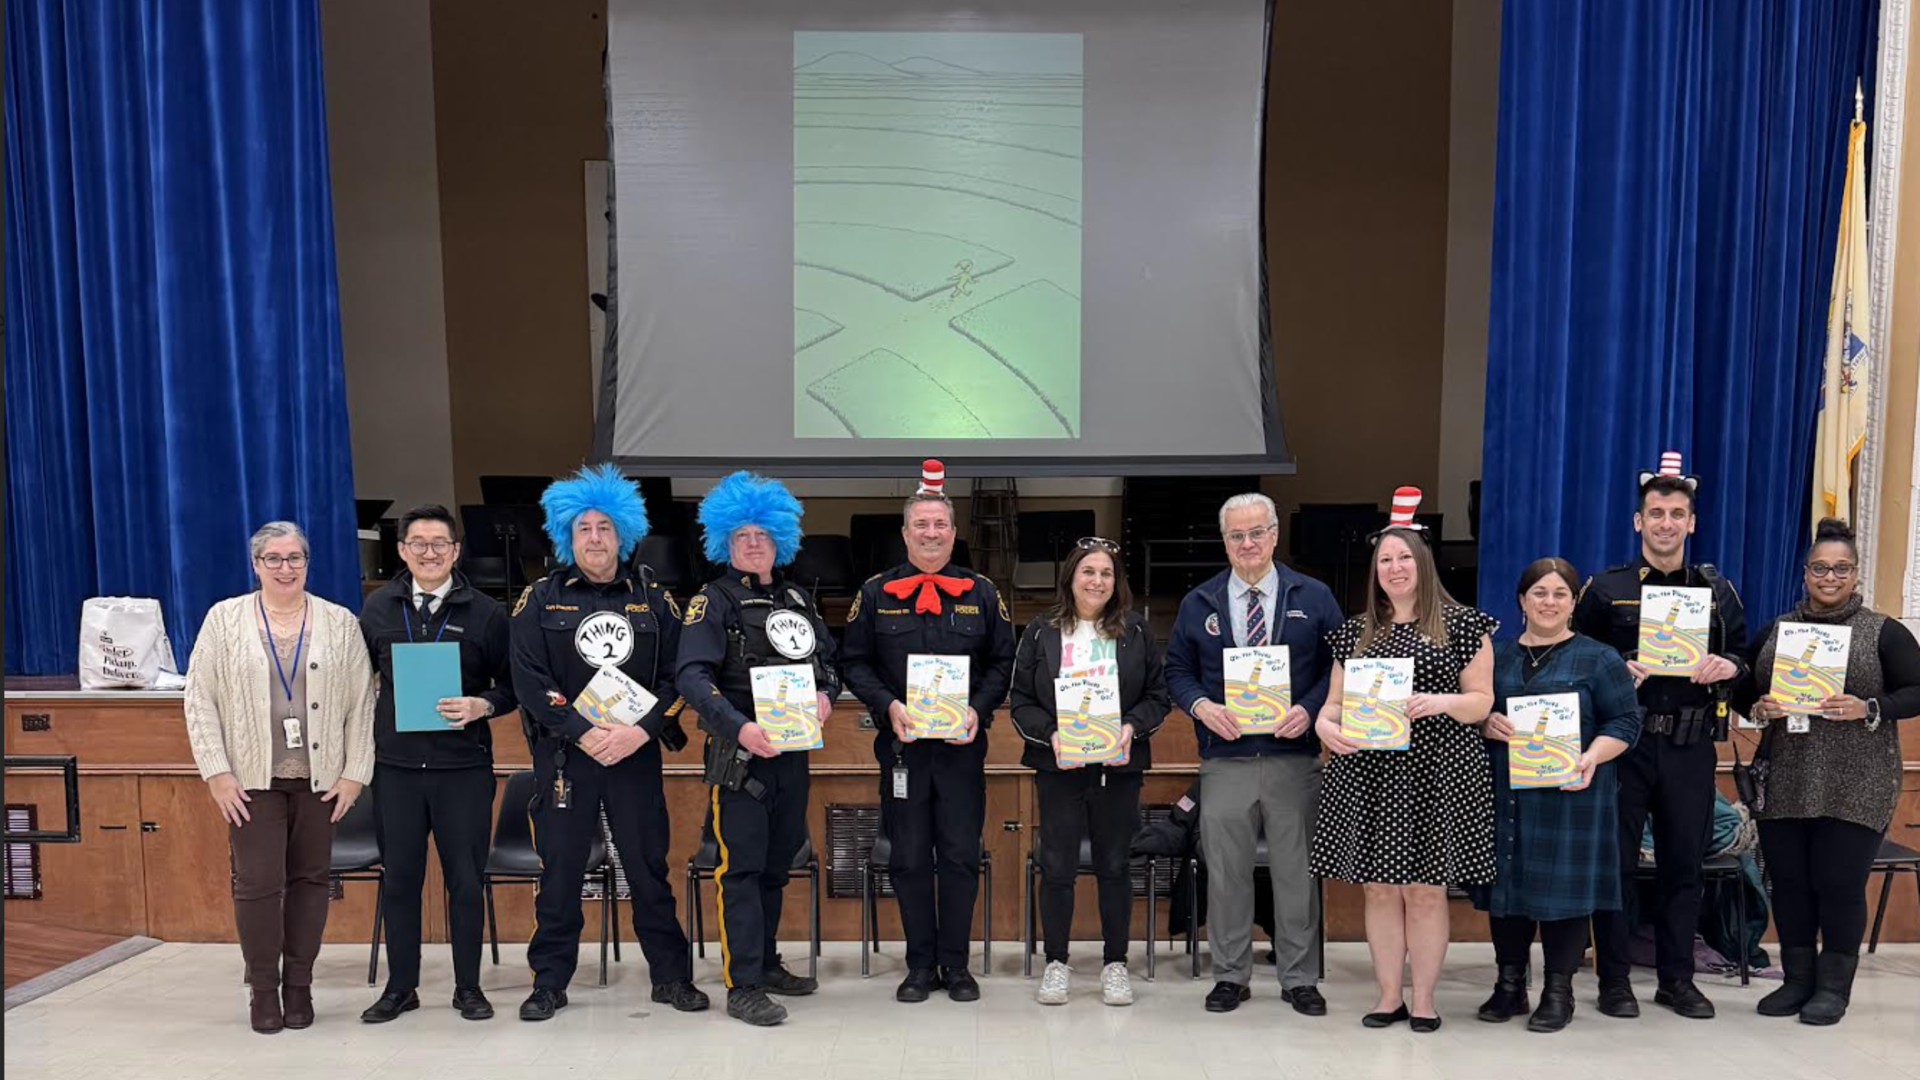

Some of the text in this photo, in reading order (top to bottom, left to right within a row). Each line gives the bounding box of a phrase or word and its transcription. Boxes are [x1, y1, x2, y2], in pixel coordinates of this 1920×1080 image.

[579, 621, 628, 645] THING
[769, 618, 808, 637] THING
[602, 641, 619, 660] 2
[789, 634, 802, 650] 1
